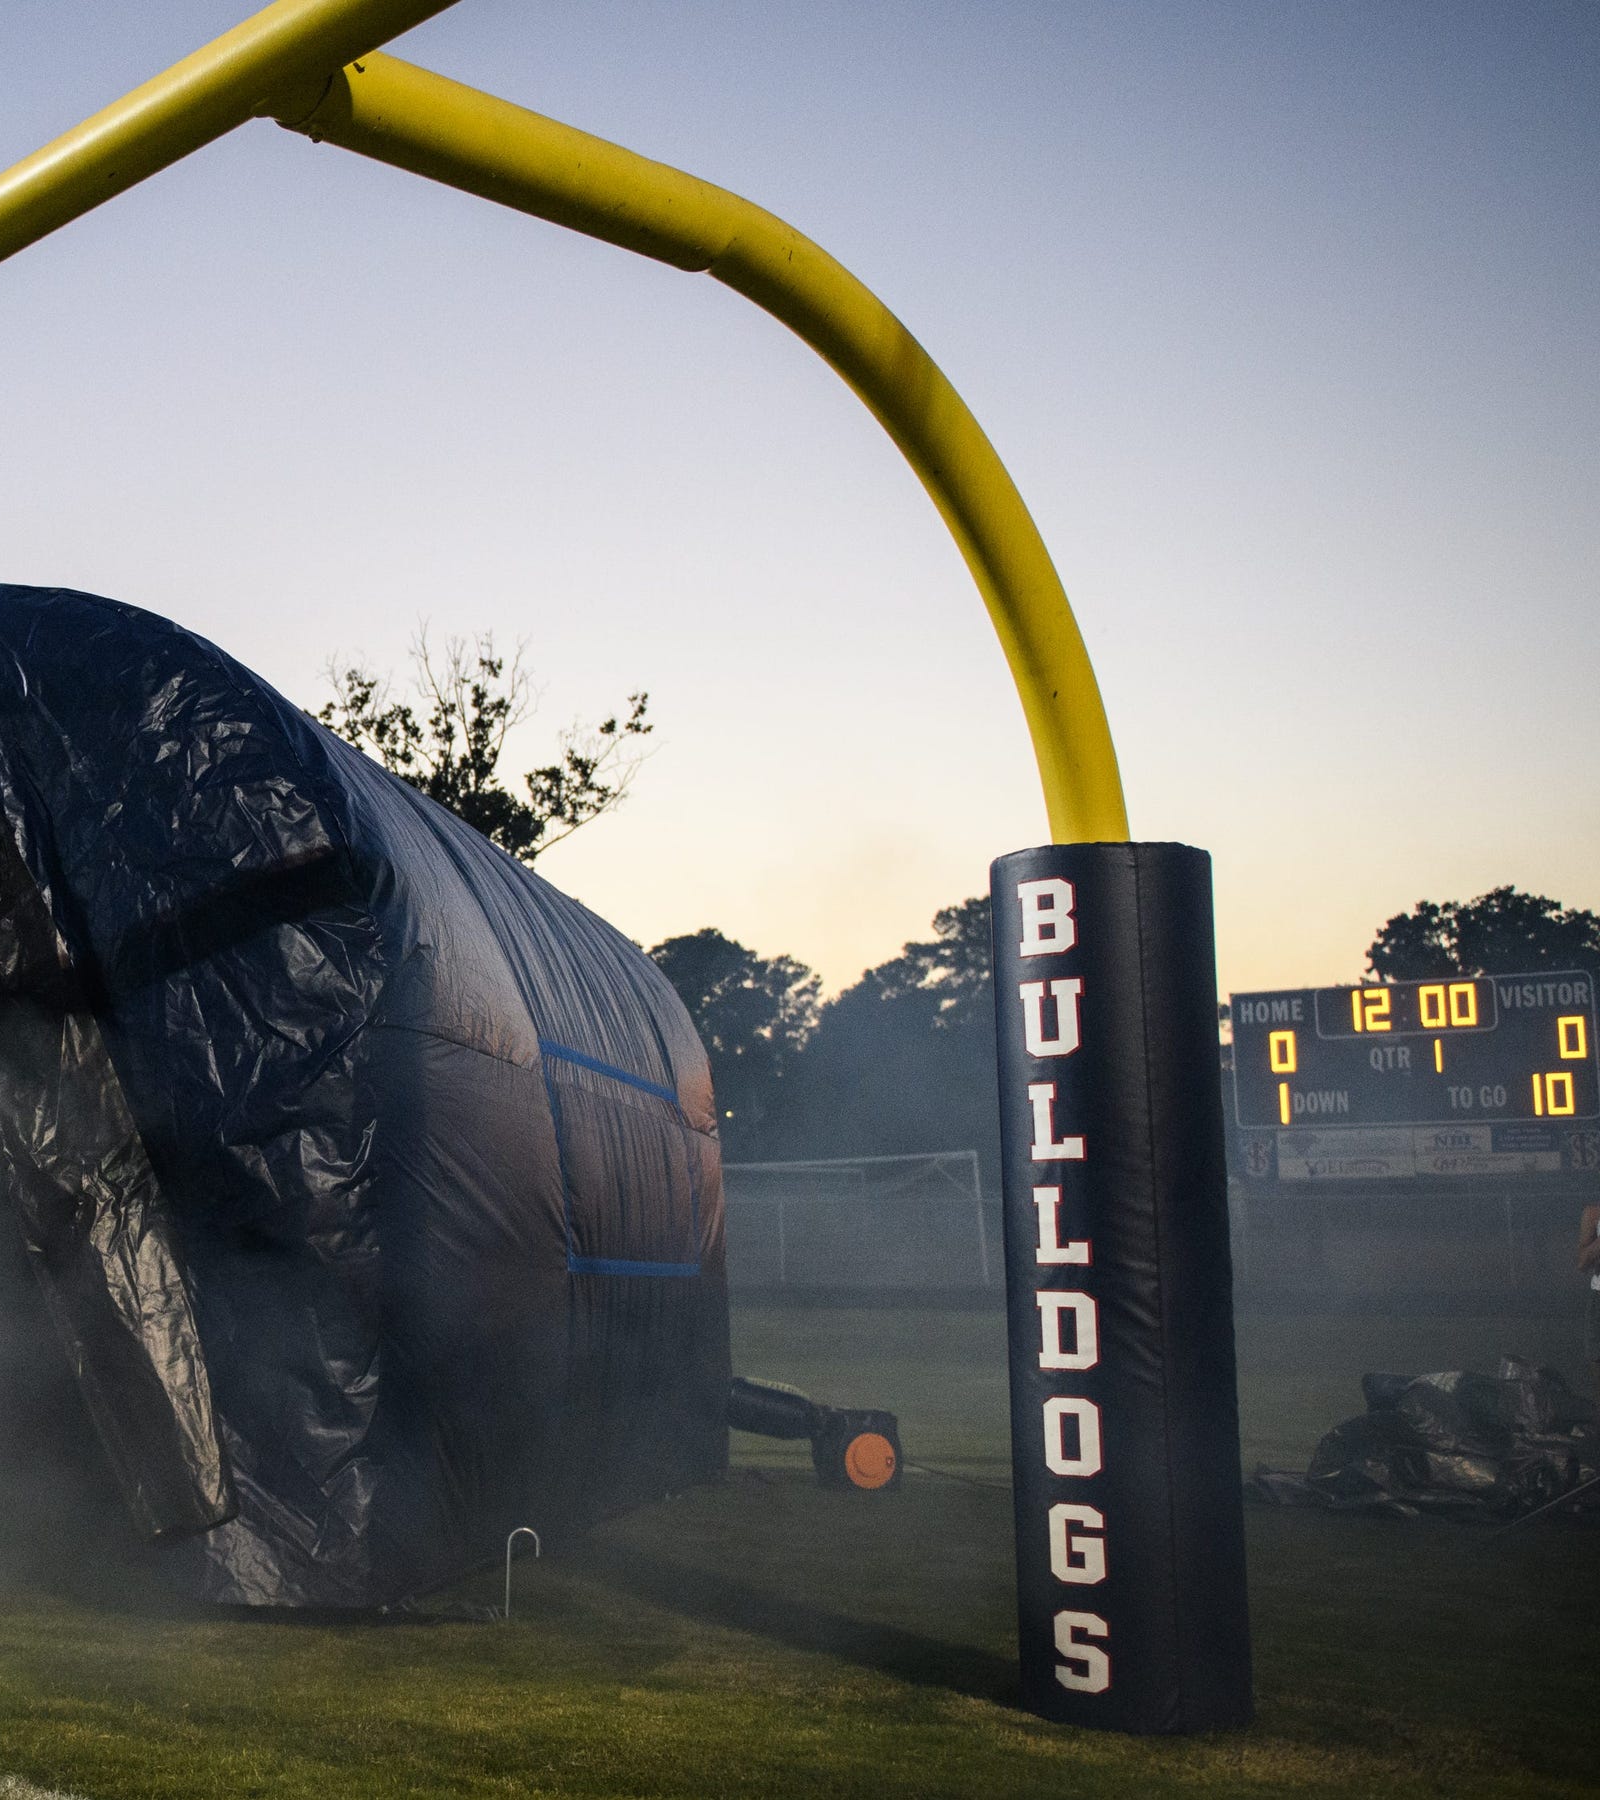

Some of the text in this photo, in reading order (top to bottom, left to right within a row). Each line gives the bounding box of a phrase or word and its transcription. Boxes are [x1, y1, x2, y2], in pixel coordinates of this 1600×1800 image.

[1240, 999, 1304, 1024] HOME
[1500, 981, 1590, 1009] VISITOR
[1268, 1030, 1298, 1074] 0
[1556, 1015, 1588, 1060] 0
[1369, 1046, 1411, 1073] QTR
[1278, 1082, 1291, 1126] 1
[1294, 1090, 1350, 1114] DOWN
[1447, 1084, 1507, 1108] TO GO
[1532, 1071, 1576, 1117] 10
[1016, 877, 1114, 1695] BULLDOGS
